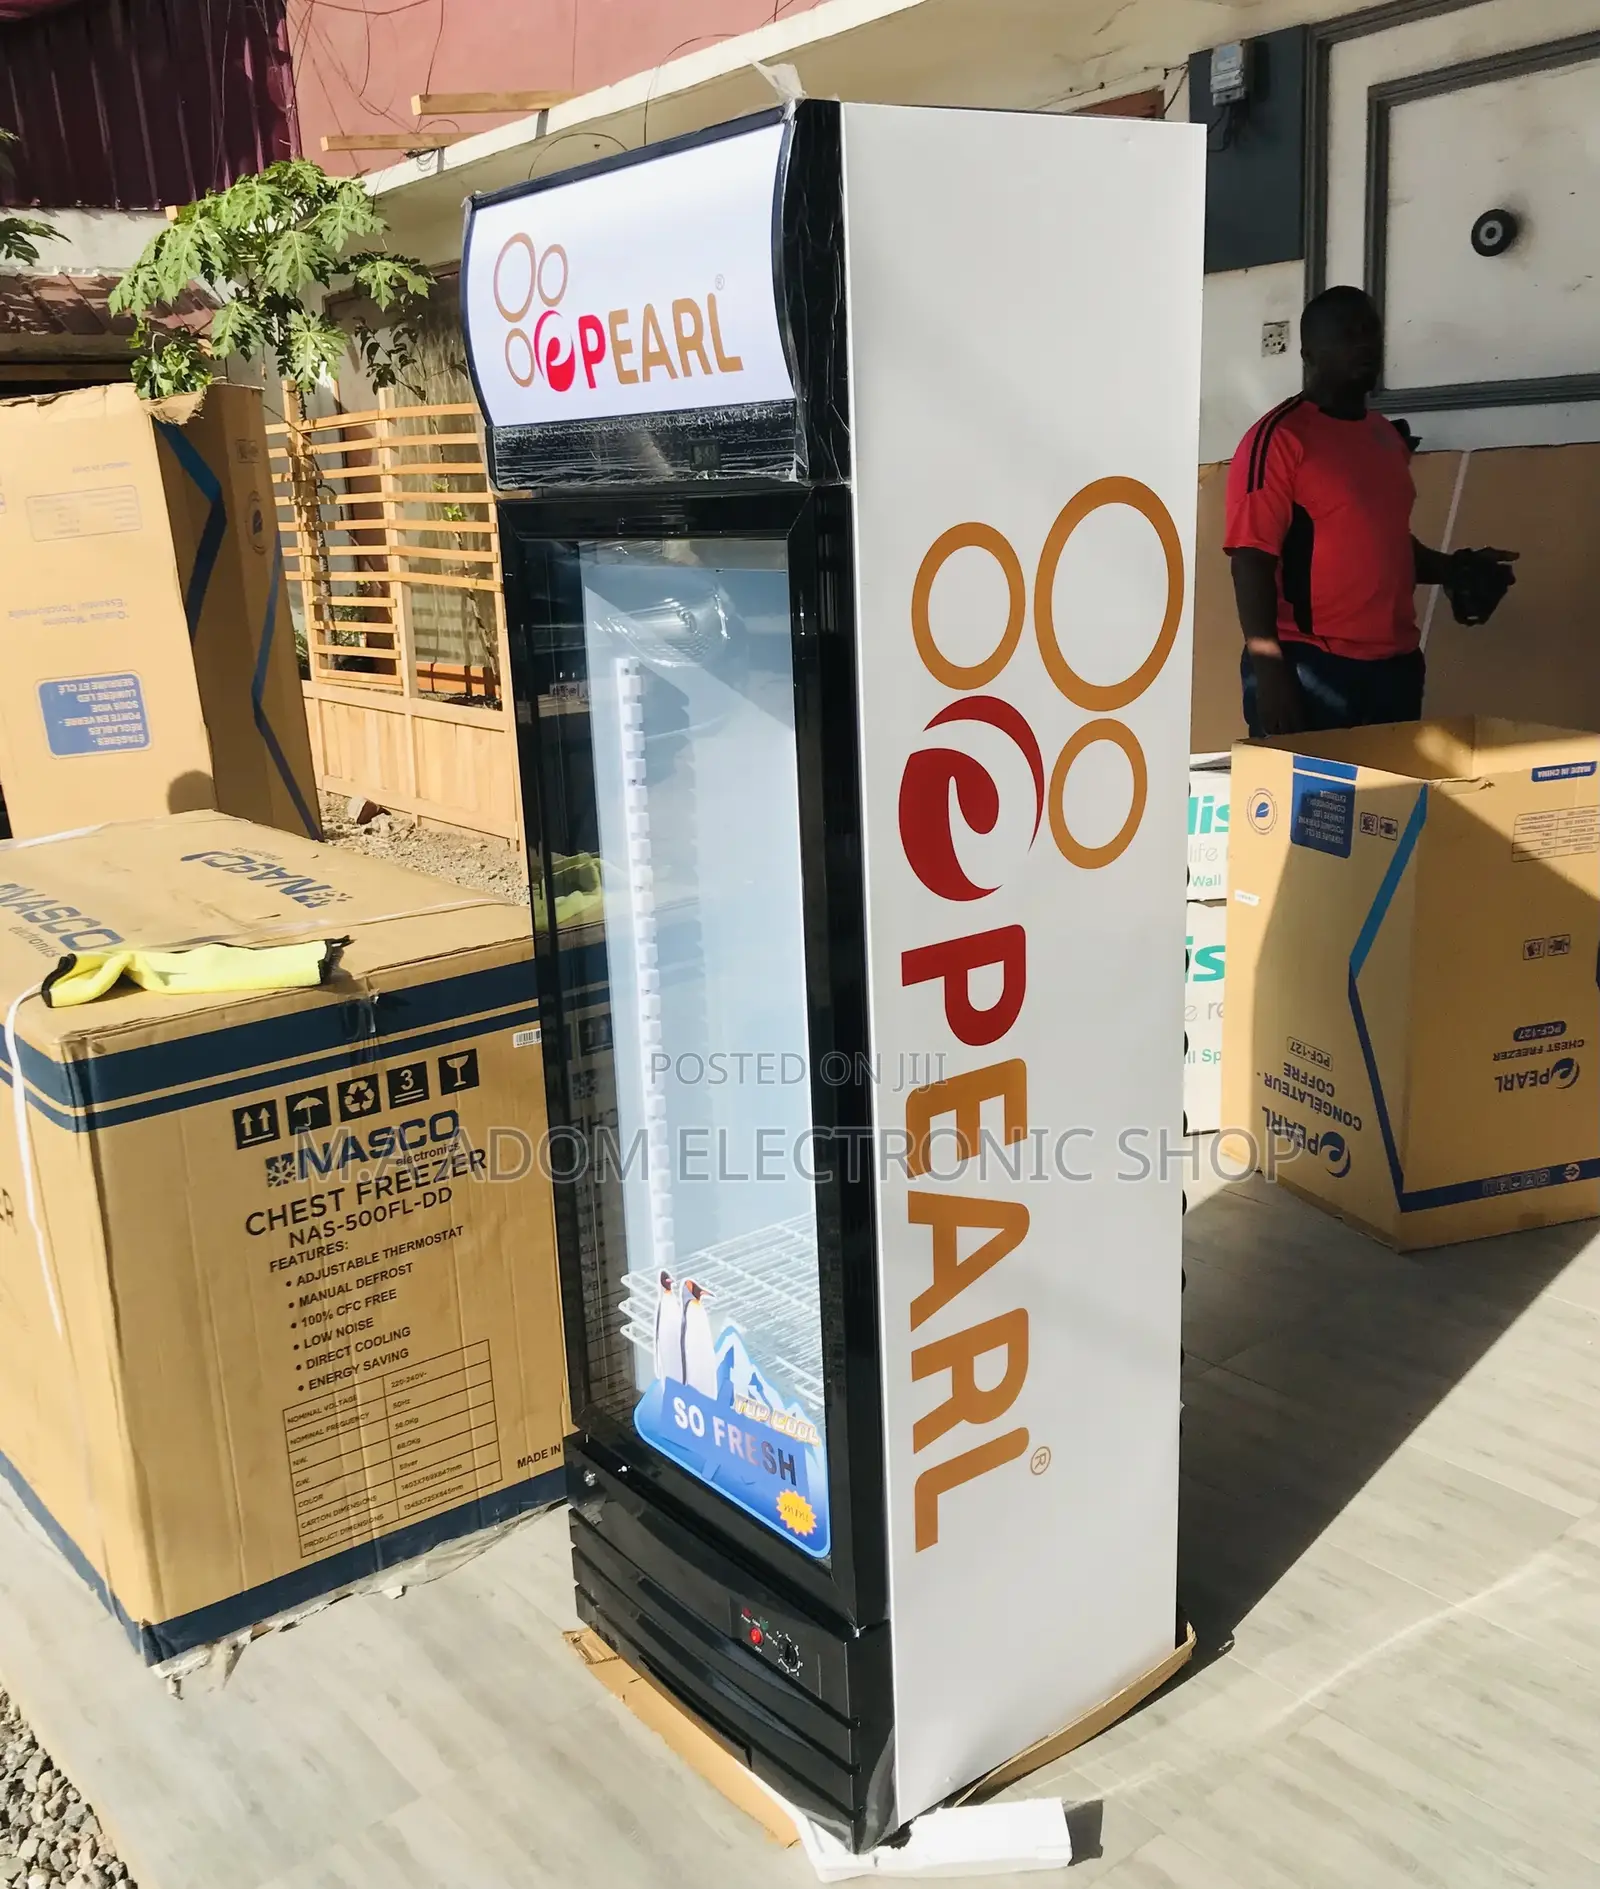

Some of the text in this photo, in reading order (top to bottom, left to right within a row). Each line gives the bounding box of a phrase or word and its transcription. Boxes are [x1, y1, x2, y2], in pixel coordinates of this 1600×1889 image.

[1192, 874, 1221, 887] Wall
[1289, 1040, 1331, 1068] PCF-127
[1493, 1038, 1584, 1061] CHEST FREEZER
[1283, 1061, 1335, 1098] COFFRE
[1494, 1067, 1551, 1093] PEARL
[1264, 1072, 1363, 1132] CONGÉLATEUR
[300, 1109, 460, 1179] NASCO
[396, 1140, 460, 1167] electronics
[245, 1148, 487, 1236] CHEST FREEZER
[289, 1186, 453, 1249] NAS-500FL-DD
[270, 1240, 348, 1272] FEATURES:
[296, 1226, 464, 1286] ADJUSTABLE THERMOSTAT
[299, 1262, 414, 1307] MANUAL DEFROST
[301, 1288, 397, 1328] 100% CFC FREE
[304, 1317, 374, 1349] LOW NOISE
[306, 1326, 411, 1370] DIRECT COOLING
[309, 1347, 410, 1390] ENERGY SAVING
[287, 1407, 322, 1424] NOMINAL
[324, 1394, 358, 1412] VOLTAGE
[735, 1394, 821, 1448] TOP COOL
[290, 1428, 324, 1445] NOMINAL
[326, 1411, 370, 1432] FREQUENCY
[672, 1396, 797, 1486] SO FRESH
[517, 1443, 561, 1469] MADE IN
[298, 1494, 324, 1508] COLOR
[301, 1513, 331, 1528] CARTON
[333, 1495, 377, 1517] DIMENSIONS
[304, 1532, 338, 1549] PRODUCT
[340, 1513, 384, 1534] DIMENSIONS
